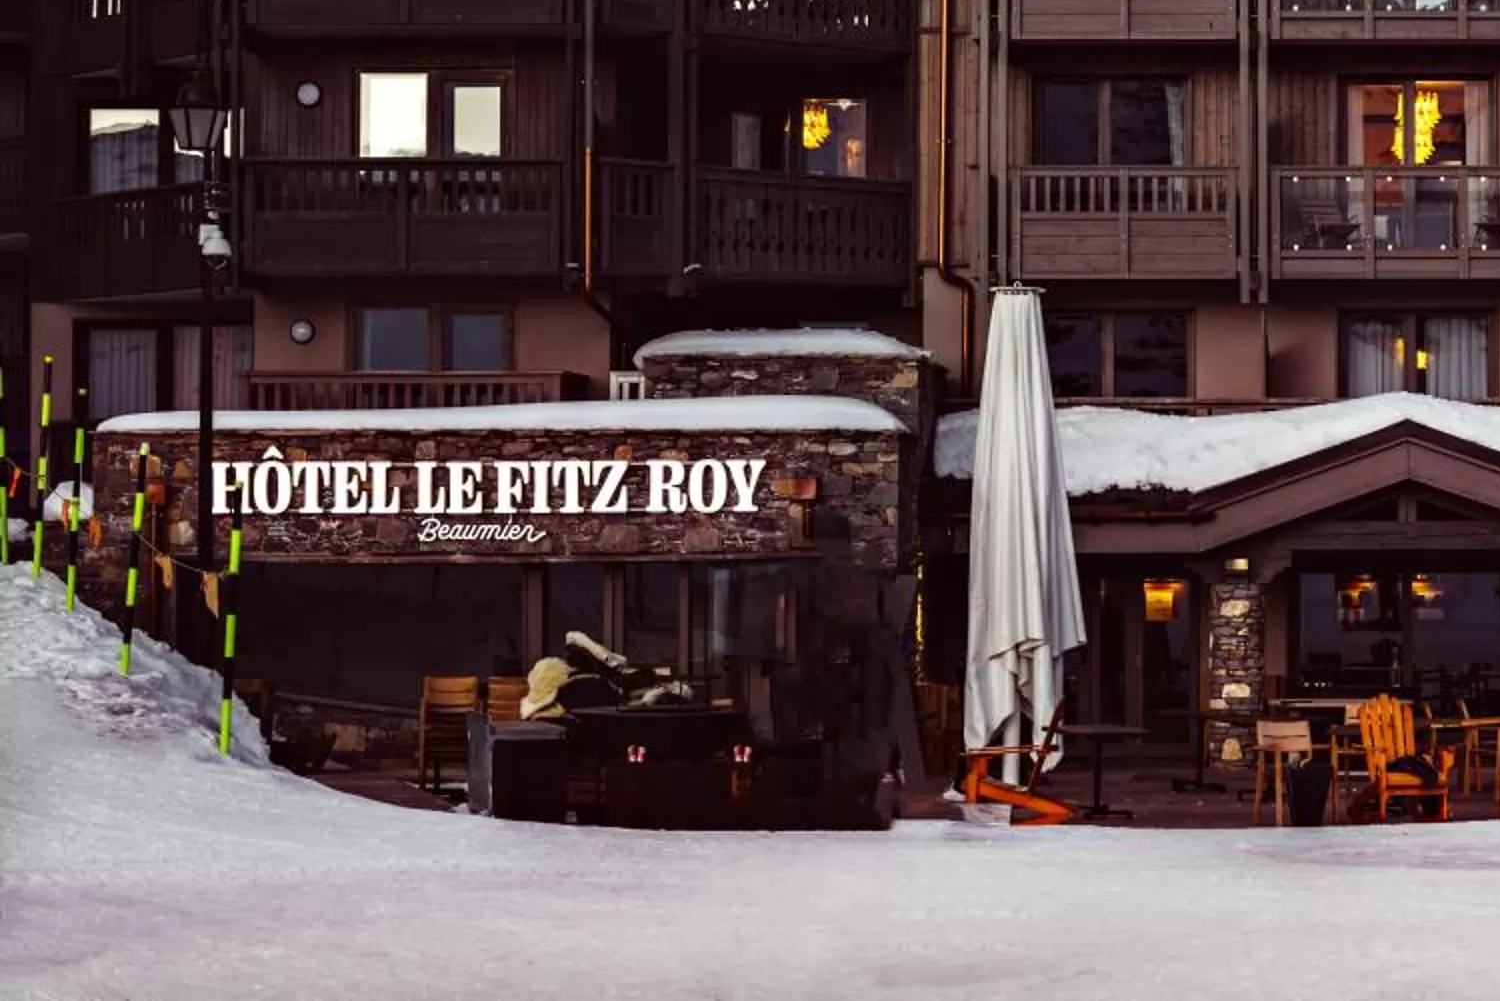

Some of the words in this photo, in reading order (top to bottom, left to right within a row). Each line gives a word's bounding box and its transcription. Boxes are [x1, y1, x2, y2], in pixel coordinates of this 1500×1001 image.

[212, 445, 400, 515] HÔTEL
[414, 460, 483, 514] LE
[494, 459, 630, 514] FITZ
[646, 459, 767, 514] ROY
[417, 516, 547, 542] Beaumier
